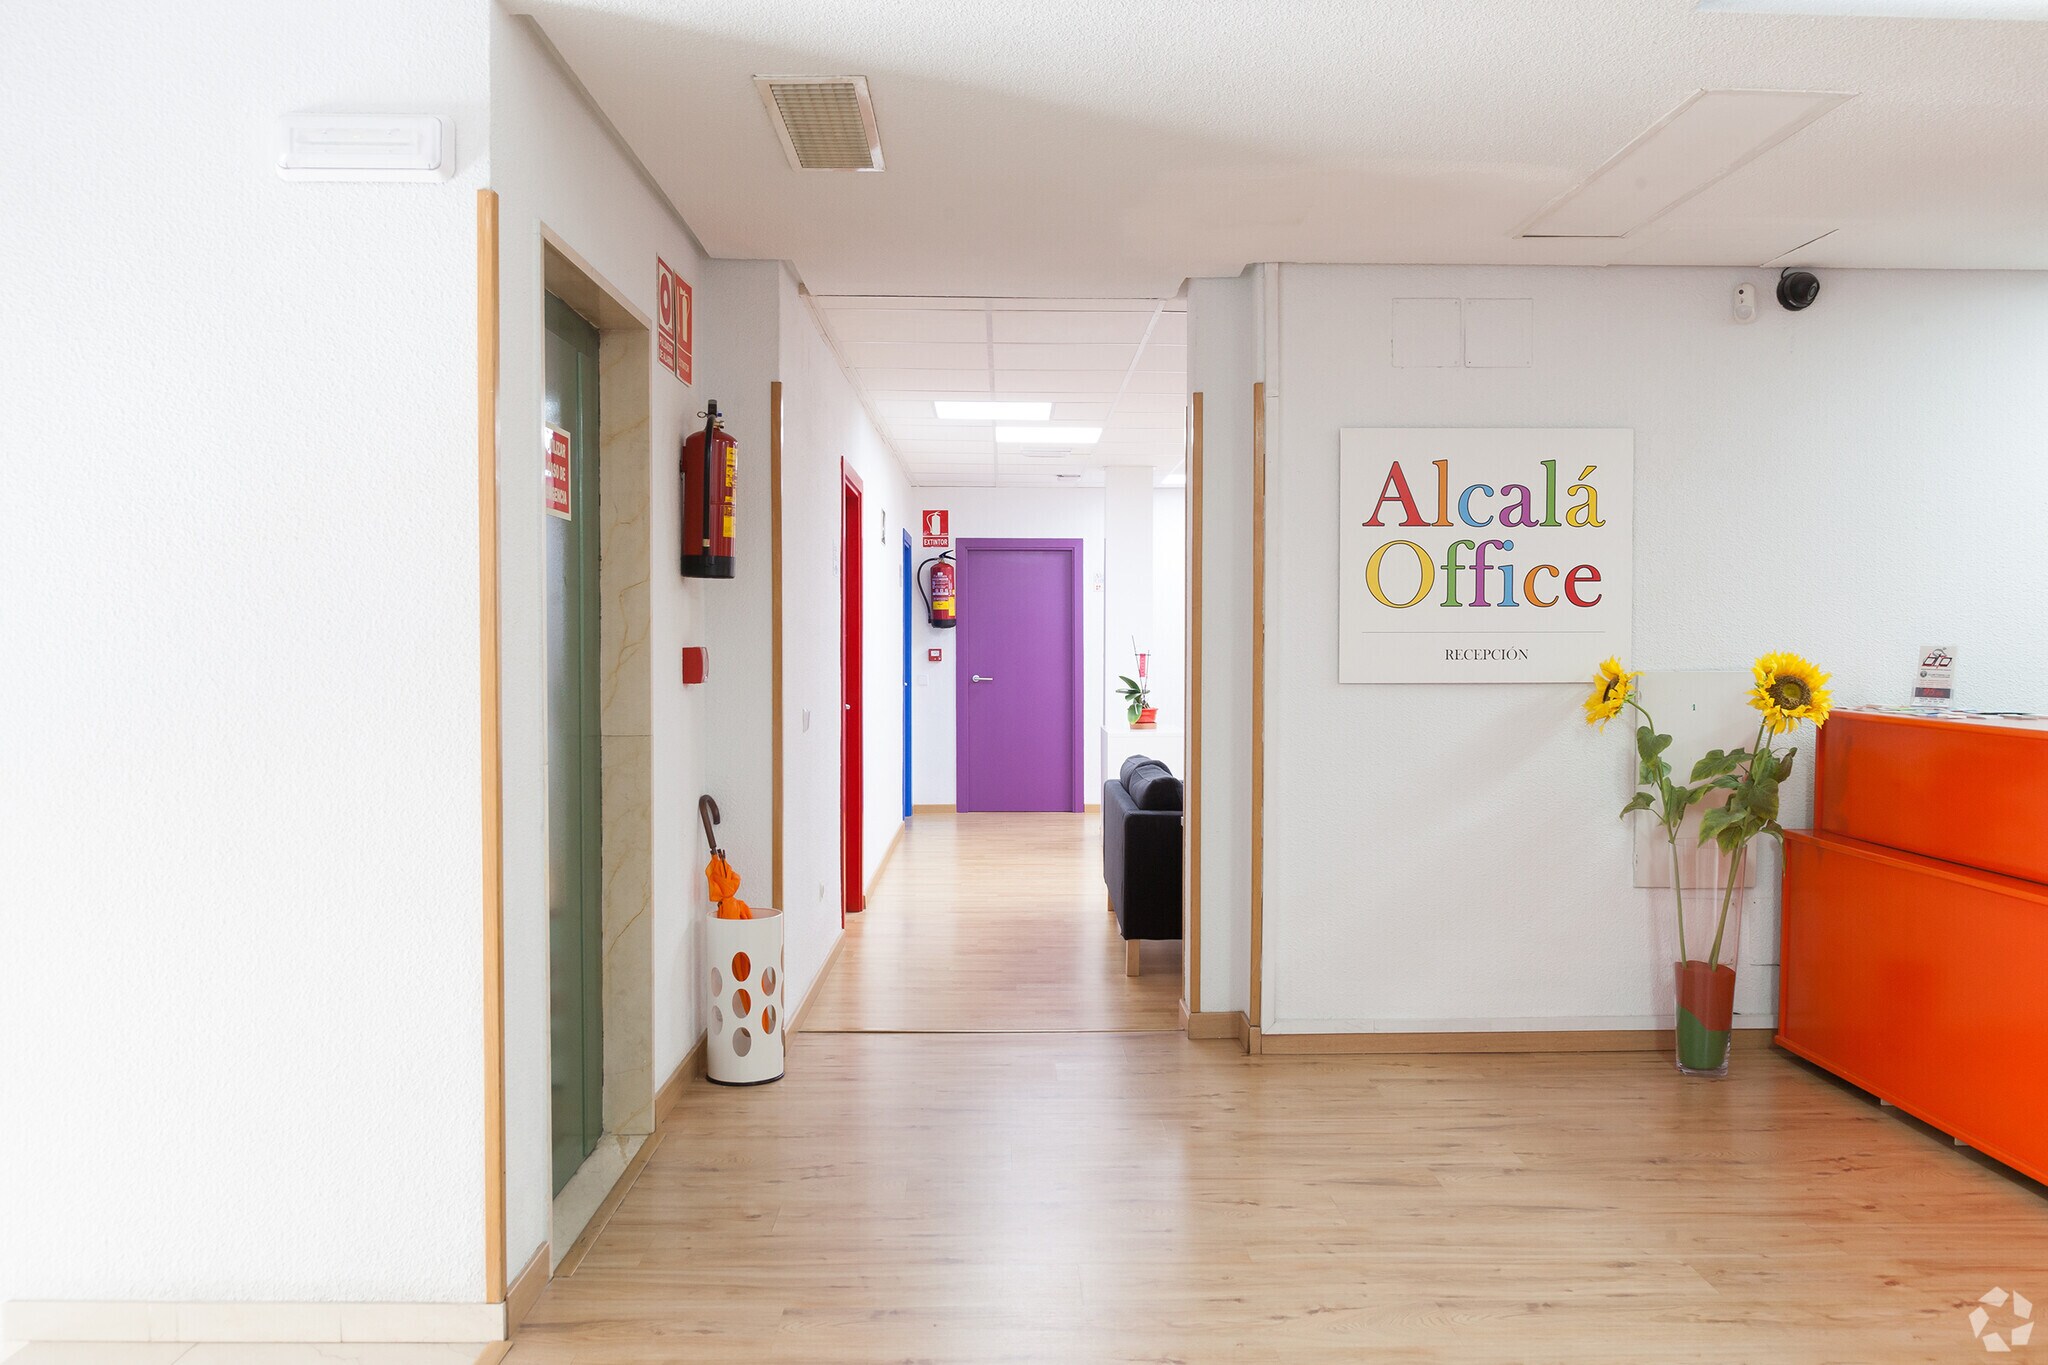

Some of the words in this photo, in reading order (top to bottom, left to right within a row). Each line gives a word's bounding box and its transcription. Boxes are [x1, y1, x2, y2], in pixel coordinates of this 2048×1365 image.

[1362, 459, 1606, 527] Alcalá
[1365, 539, 1602, 609] Office
[1444, 646, 1529, 661] RECEPCIÓN
